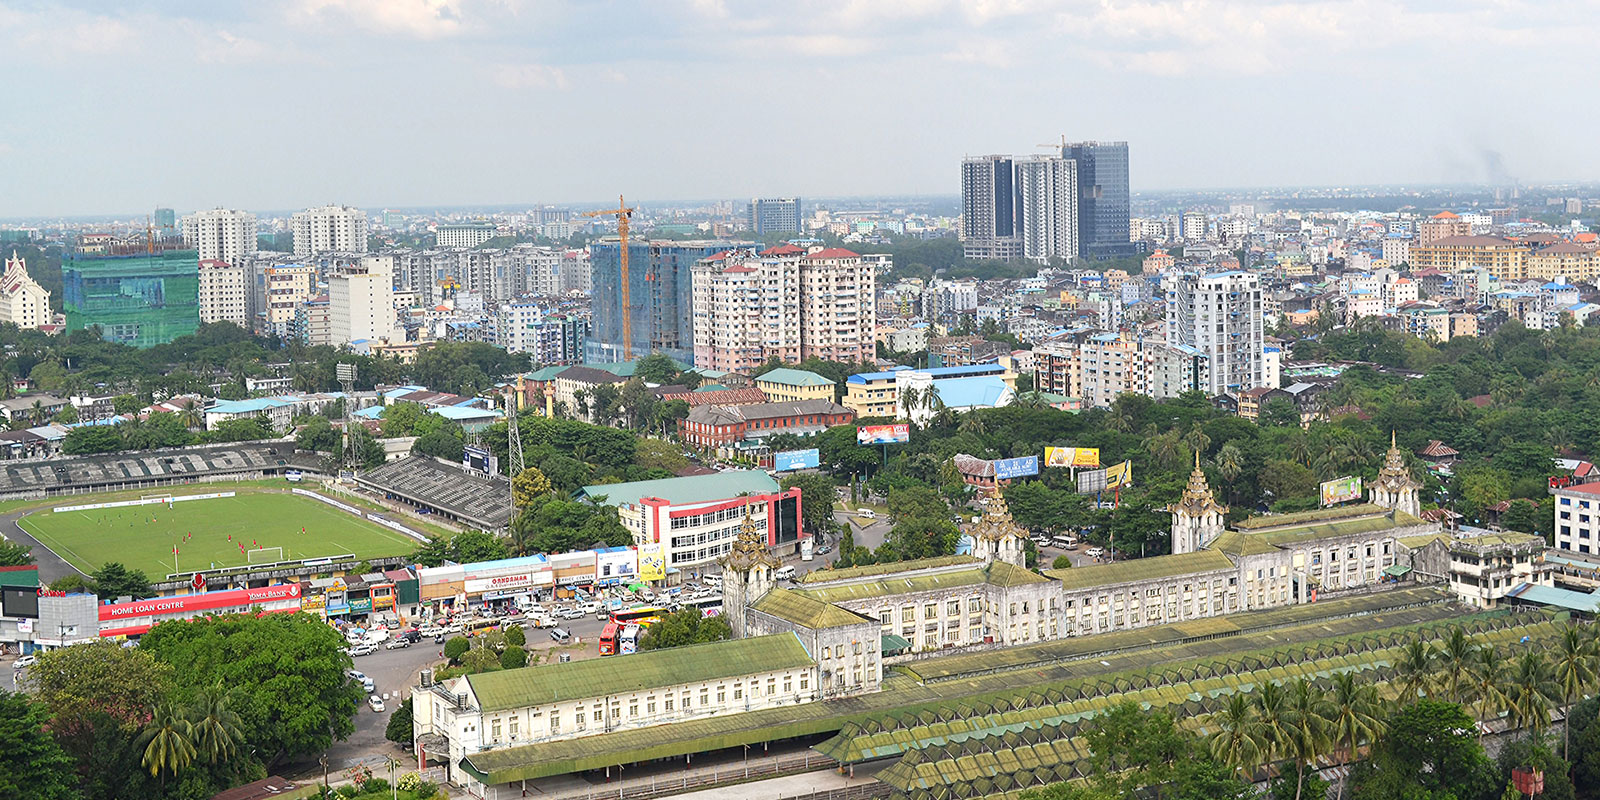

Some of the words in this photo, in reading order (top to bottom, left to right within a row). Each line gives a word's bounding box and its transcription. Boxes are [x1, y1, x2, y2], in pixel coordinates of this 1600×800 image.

[36, 588, 66, 598] Canon
[111, 606, 134, 616] HOME
[135, 604, 155, 613] LOAN
[156, 601, 184, 610] CENTRE
